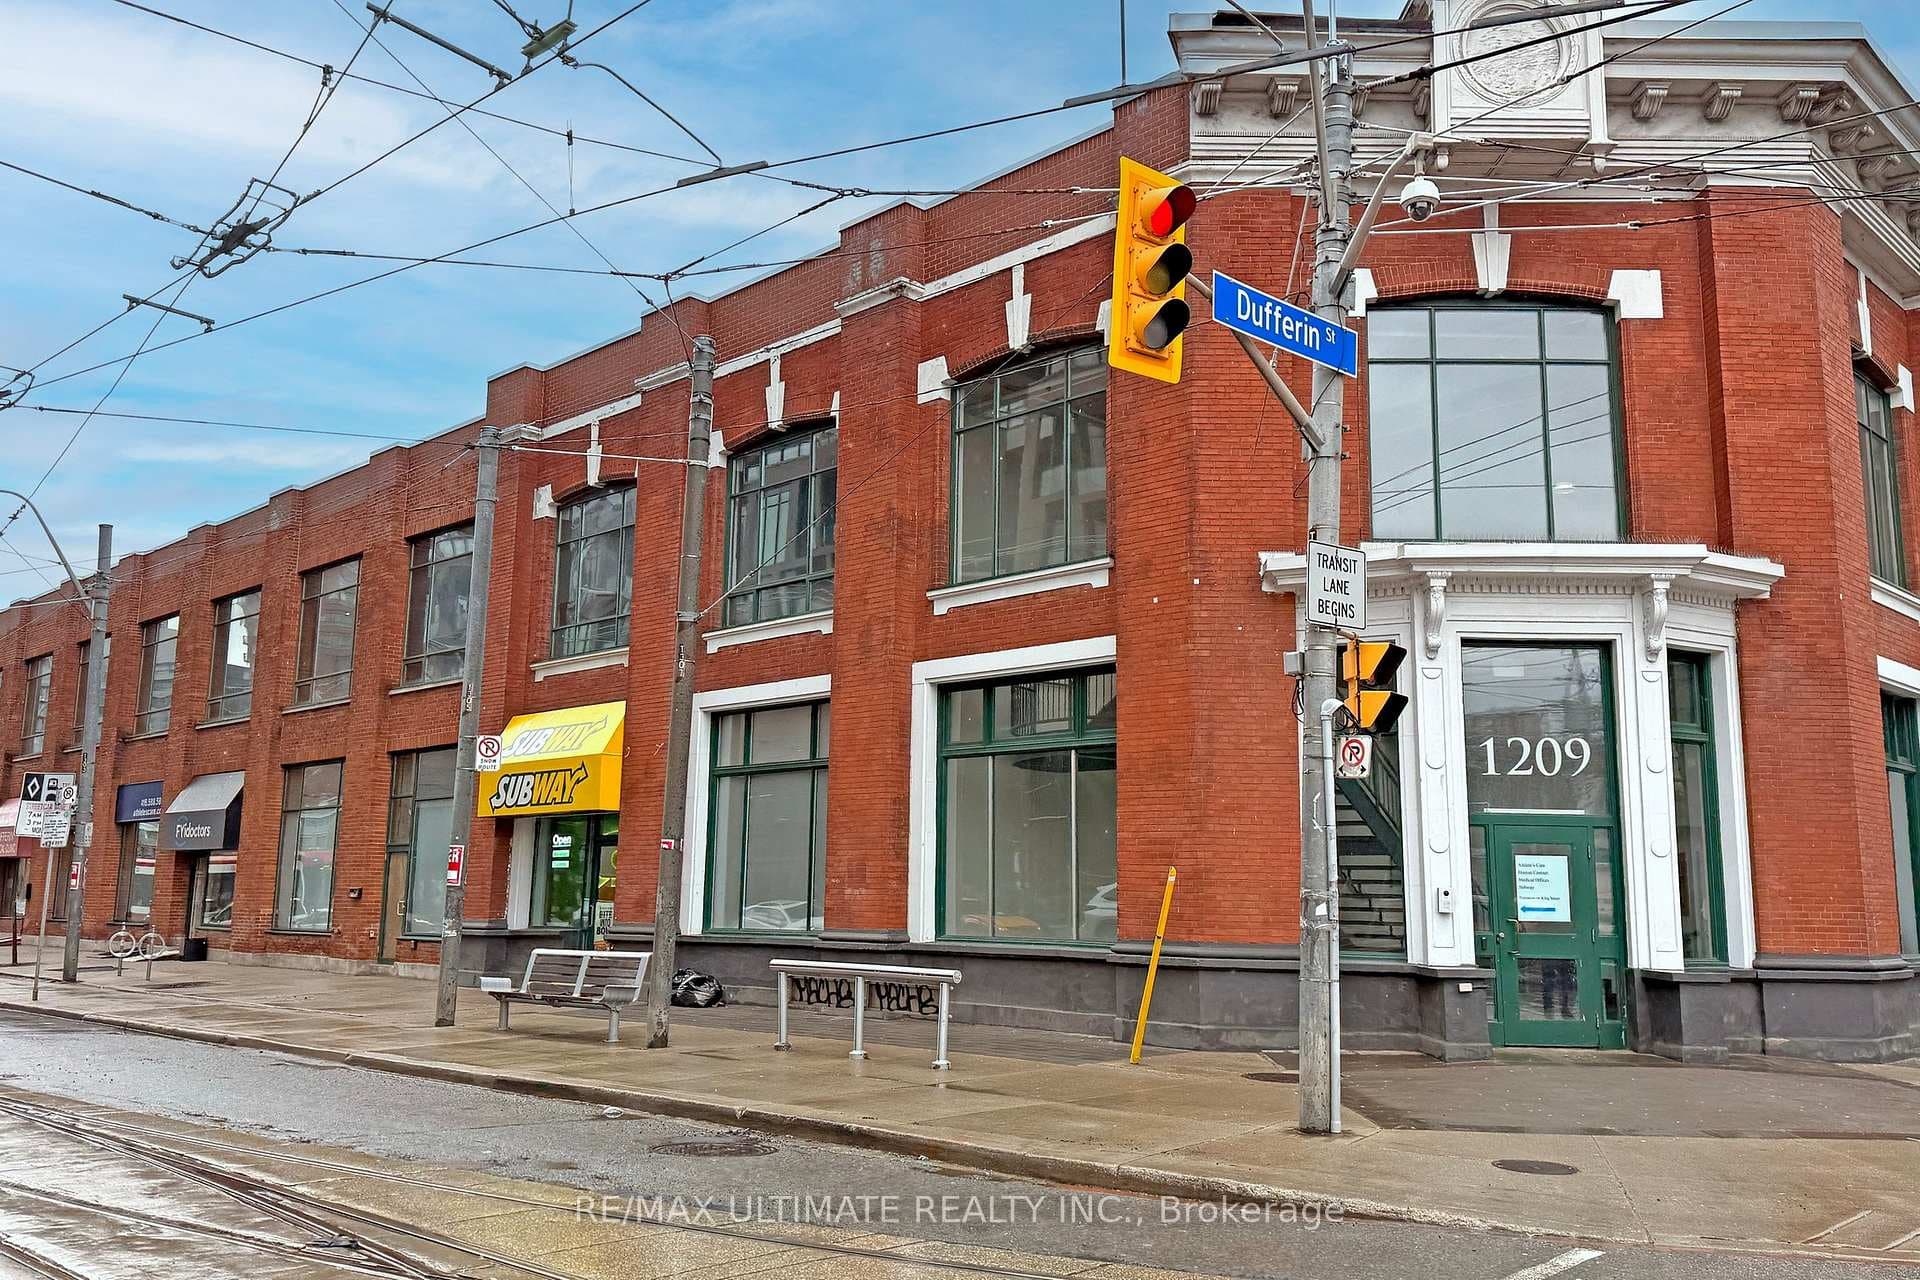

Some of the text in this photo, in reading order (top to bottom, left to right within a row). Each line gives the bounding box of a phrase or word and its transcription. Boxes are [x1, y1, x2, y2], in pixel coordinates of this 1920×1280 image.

[1237, 289, 1336, 351] Dufferin St
[1317, 552, 1357, 574] TRANSIT
[1323, 576, 1350, 596] LANE
[1318, 598, 1355, 619] BEGINS
[501, 715, 608, 758] SUBWAY
[1479, 736, 1591, 777] 1209
[489, 761, 588, 813] SUBWAY
[175, 823, 211, 838] FYidoctors
[552, 834, 571, 846] Open
